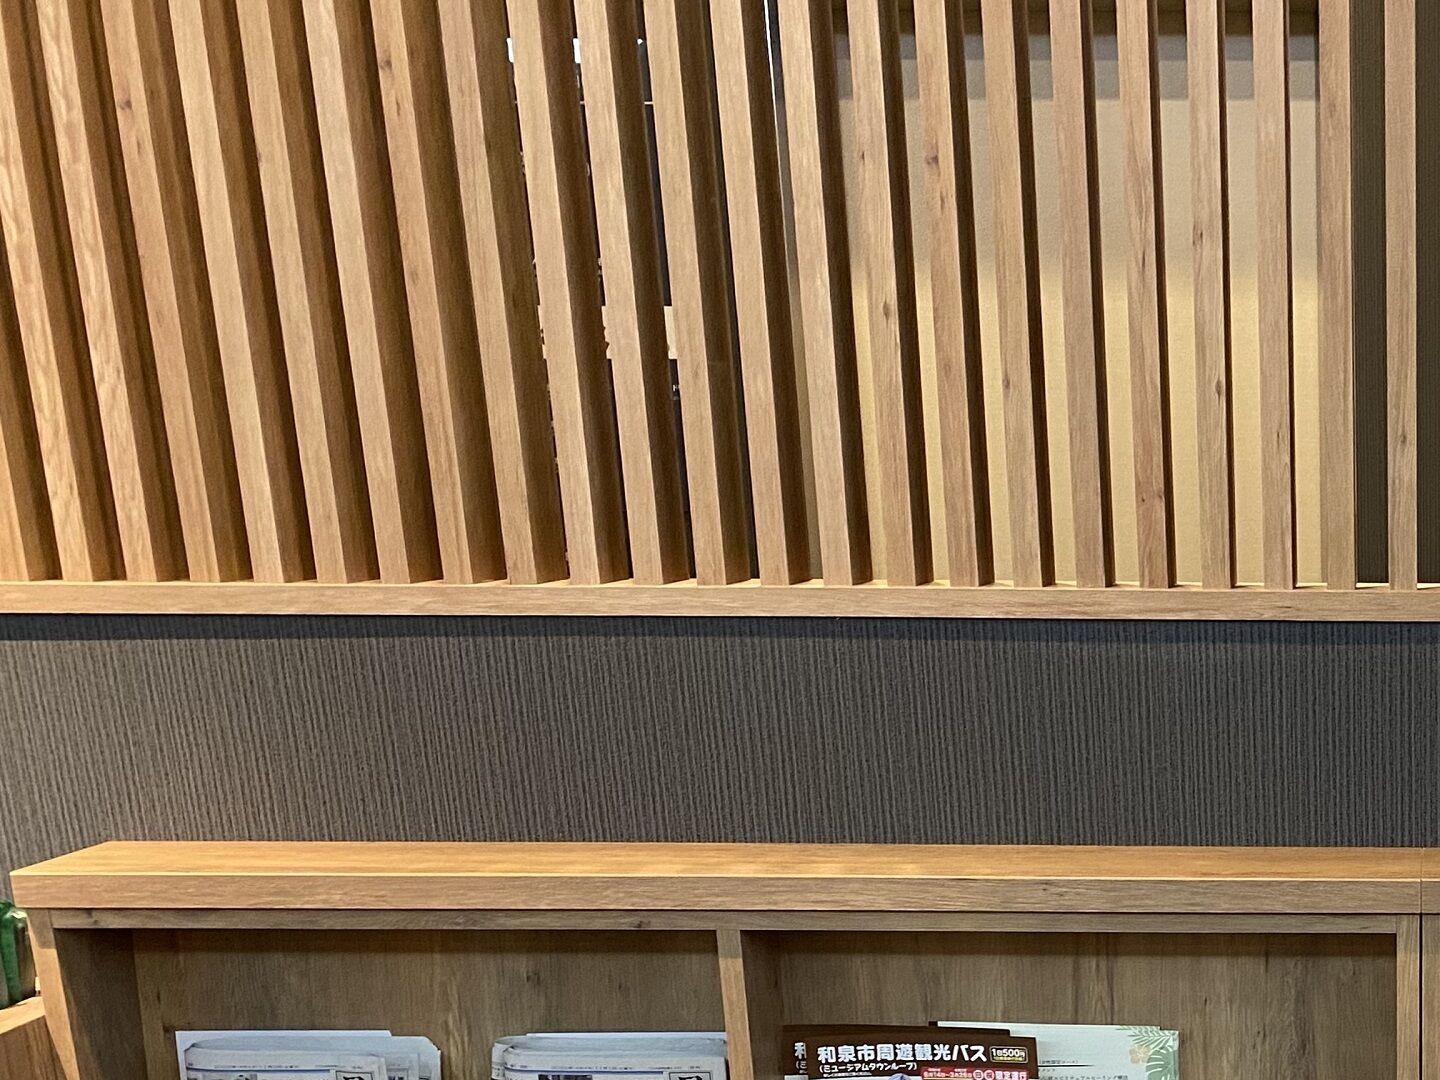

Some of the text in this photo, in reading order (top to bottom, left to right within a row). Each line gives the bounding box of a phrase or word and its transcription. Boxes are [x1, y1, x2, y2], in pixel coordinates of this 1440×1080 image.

[817, 1043, 987, 1063] 和泉市周遊観光バス
